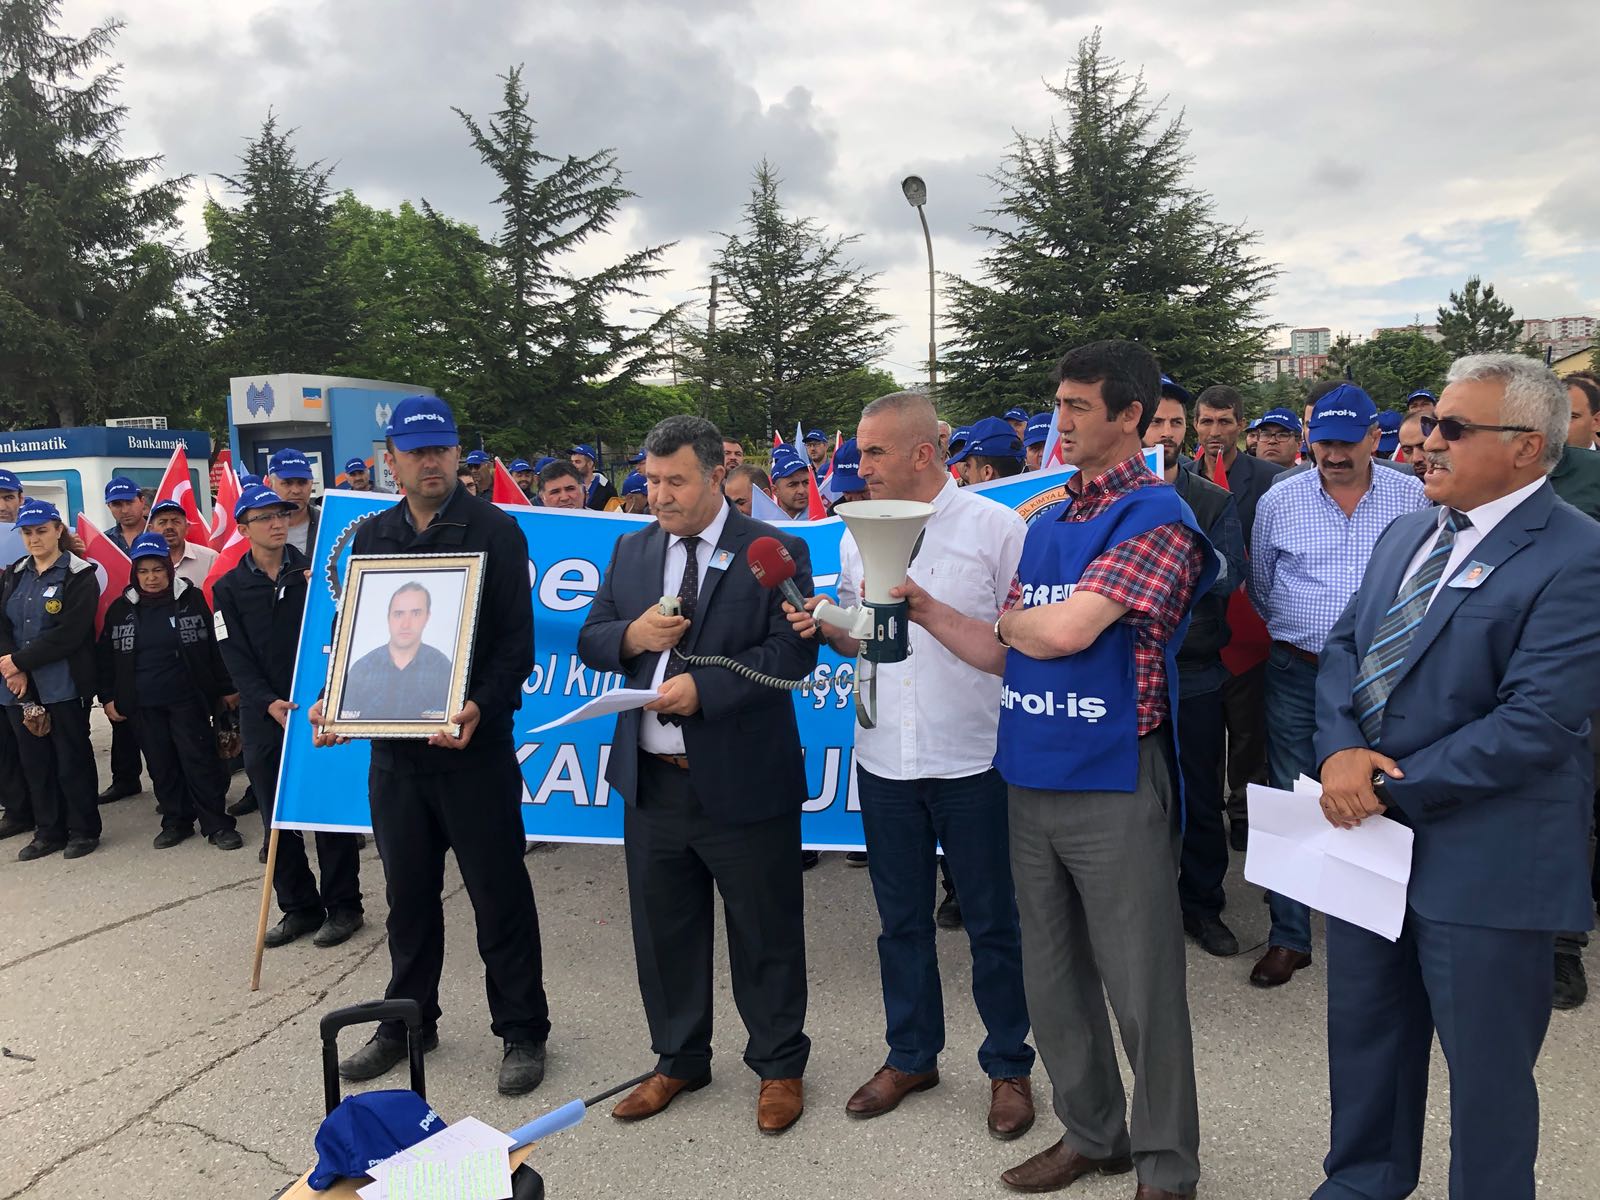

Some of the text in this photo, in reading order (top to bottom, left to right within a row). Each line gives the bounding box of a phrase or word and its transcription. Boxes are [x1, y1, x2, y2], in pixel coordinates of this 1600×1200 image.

[127, 435, 189, 451] Bankamatik
[521, 654, 557, 694] ol
[419, 1109, 438, 1132] pet
